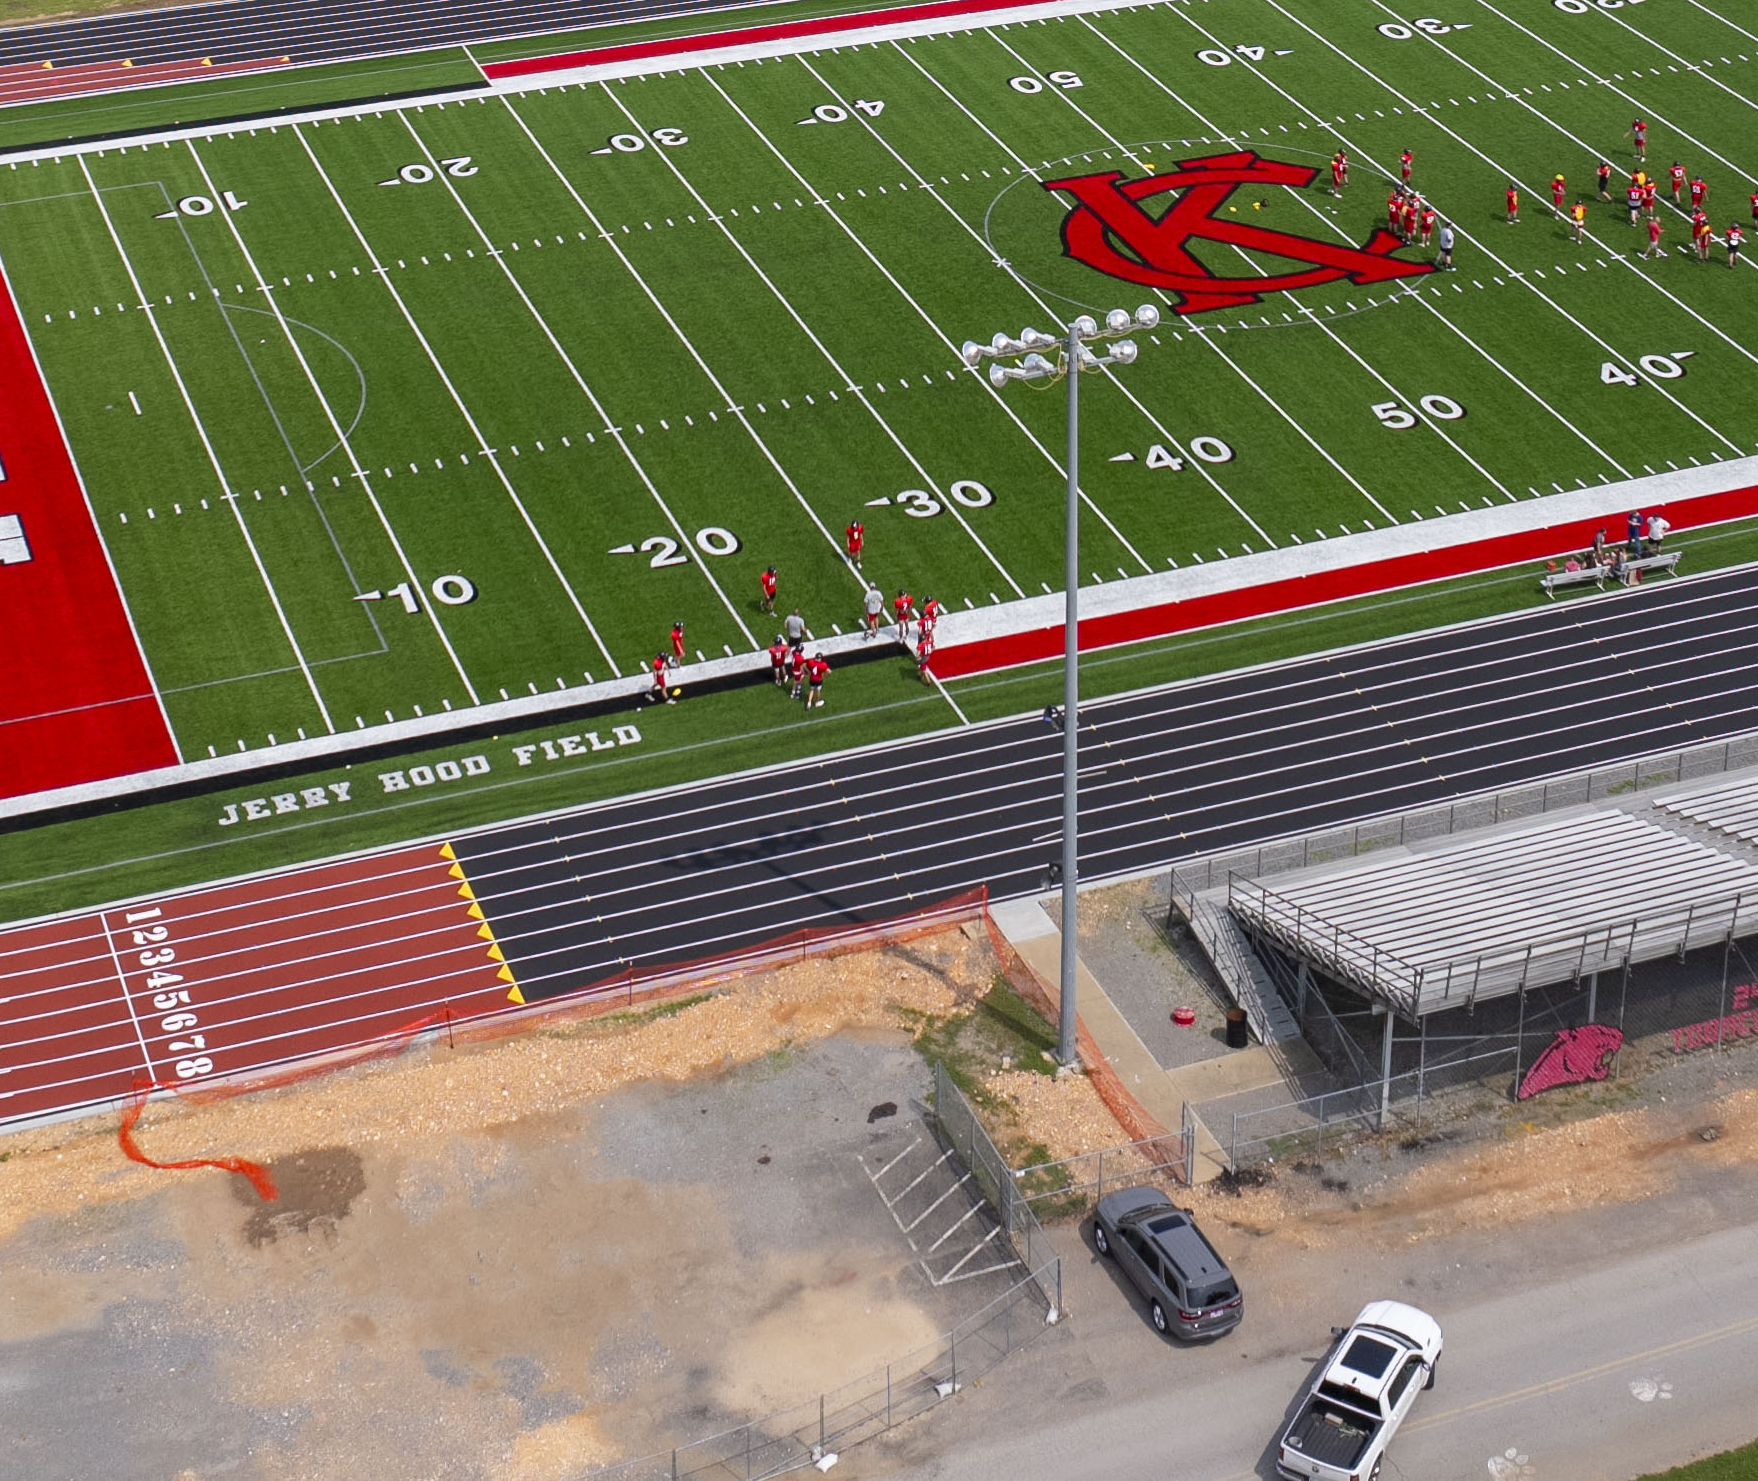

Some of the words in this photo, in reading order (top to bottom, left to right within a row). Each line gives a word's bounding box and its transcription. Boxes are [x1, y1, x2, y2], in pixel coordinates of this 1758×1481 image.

[1378, 16, 1452, 40] 30
[1197, 43, 1266, 67] 40
[1009, 70, 1084, 95] 50
[815, 98, 886, 124] 40
[610, 126, 690, 154] 30
[399, 155, 480, 185] 20
[179, 189, 249, 218] 10
[1598, 353, 1686, 389] 40
[1371, 394, 1466, 431] 50
[1145, 435, 1236, 472] 40
[896, 478, 996, 518] 30
[640, 525, 743, 569] 20
[386, 574, 479, 615] 10
[217, 781, 352, 826] JERRY
[377, 753, 492, 794] HOOD
[512, 723, 643, 767] FIELD
[125, 906, 163, 924] 1
[132, 925, 169, 945] 2
[139, 947, 176, 967] 3
[146, 971, 184, 989] 4
[153, 990, 192, 1010] 5
[161, 1012, 198, 1032] 6
[168, 1034, 206, 1052] 7
[175, 1056, 214, 1079] 8
